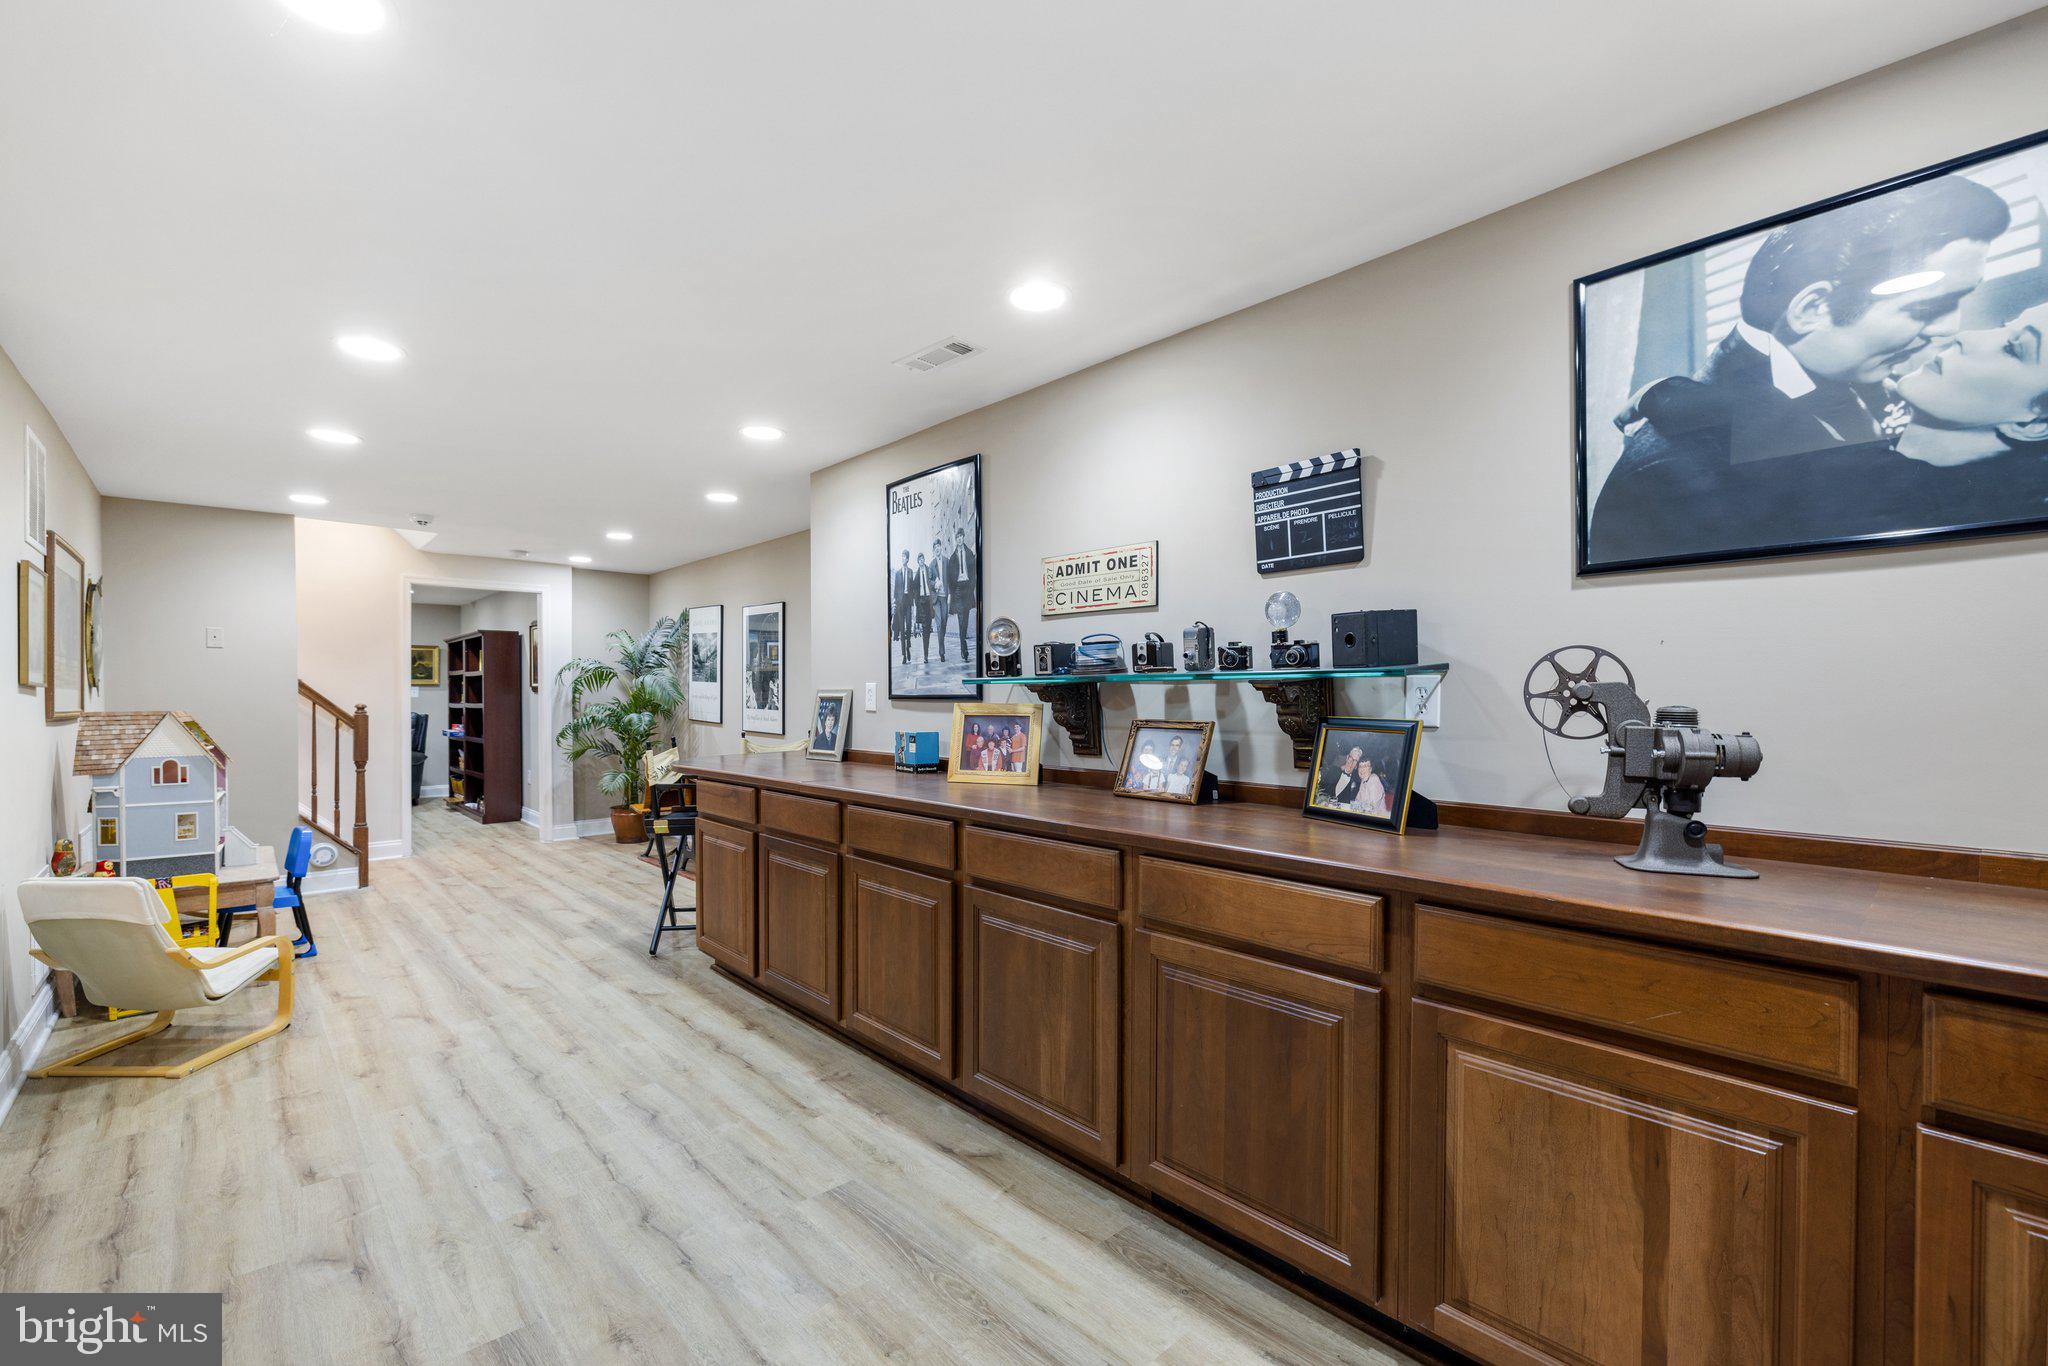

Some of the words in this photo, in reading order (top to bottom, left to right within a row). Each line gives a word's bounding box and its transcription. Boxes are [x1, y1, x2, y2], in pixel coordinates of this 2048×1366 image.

[1255, 487, 1288, 499] PRODUCTION
[892, 490, 923, 515] BEATLES
[1255, 500, 1285, 511] DIRECTEUR
[1257, 512, 1282, 523] APPAREIL
[1282, 510, 1290, 518] DE
[1290, 507, 1310, 518] PHOTO
[1293, 516, 1319, 526] PRENDRE
[1328, 510, 1357, 519] PELLICULE
[1055, 560, 1101, 578] ADMIT
[1106, 554, 1138, 571] ONE
[1261, 562, 1275, 570] DATE
[1141, 554, 1149, 597] 086327
[1055, 584, 1138, 606] CINEMA
